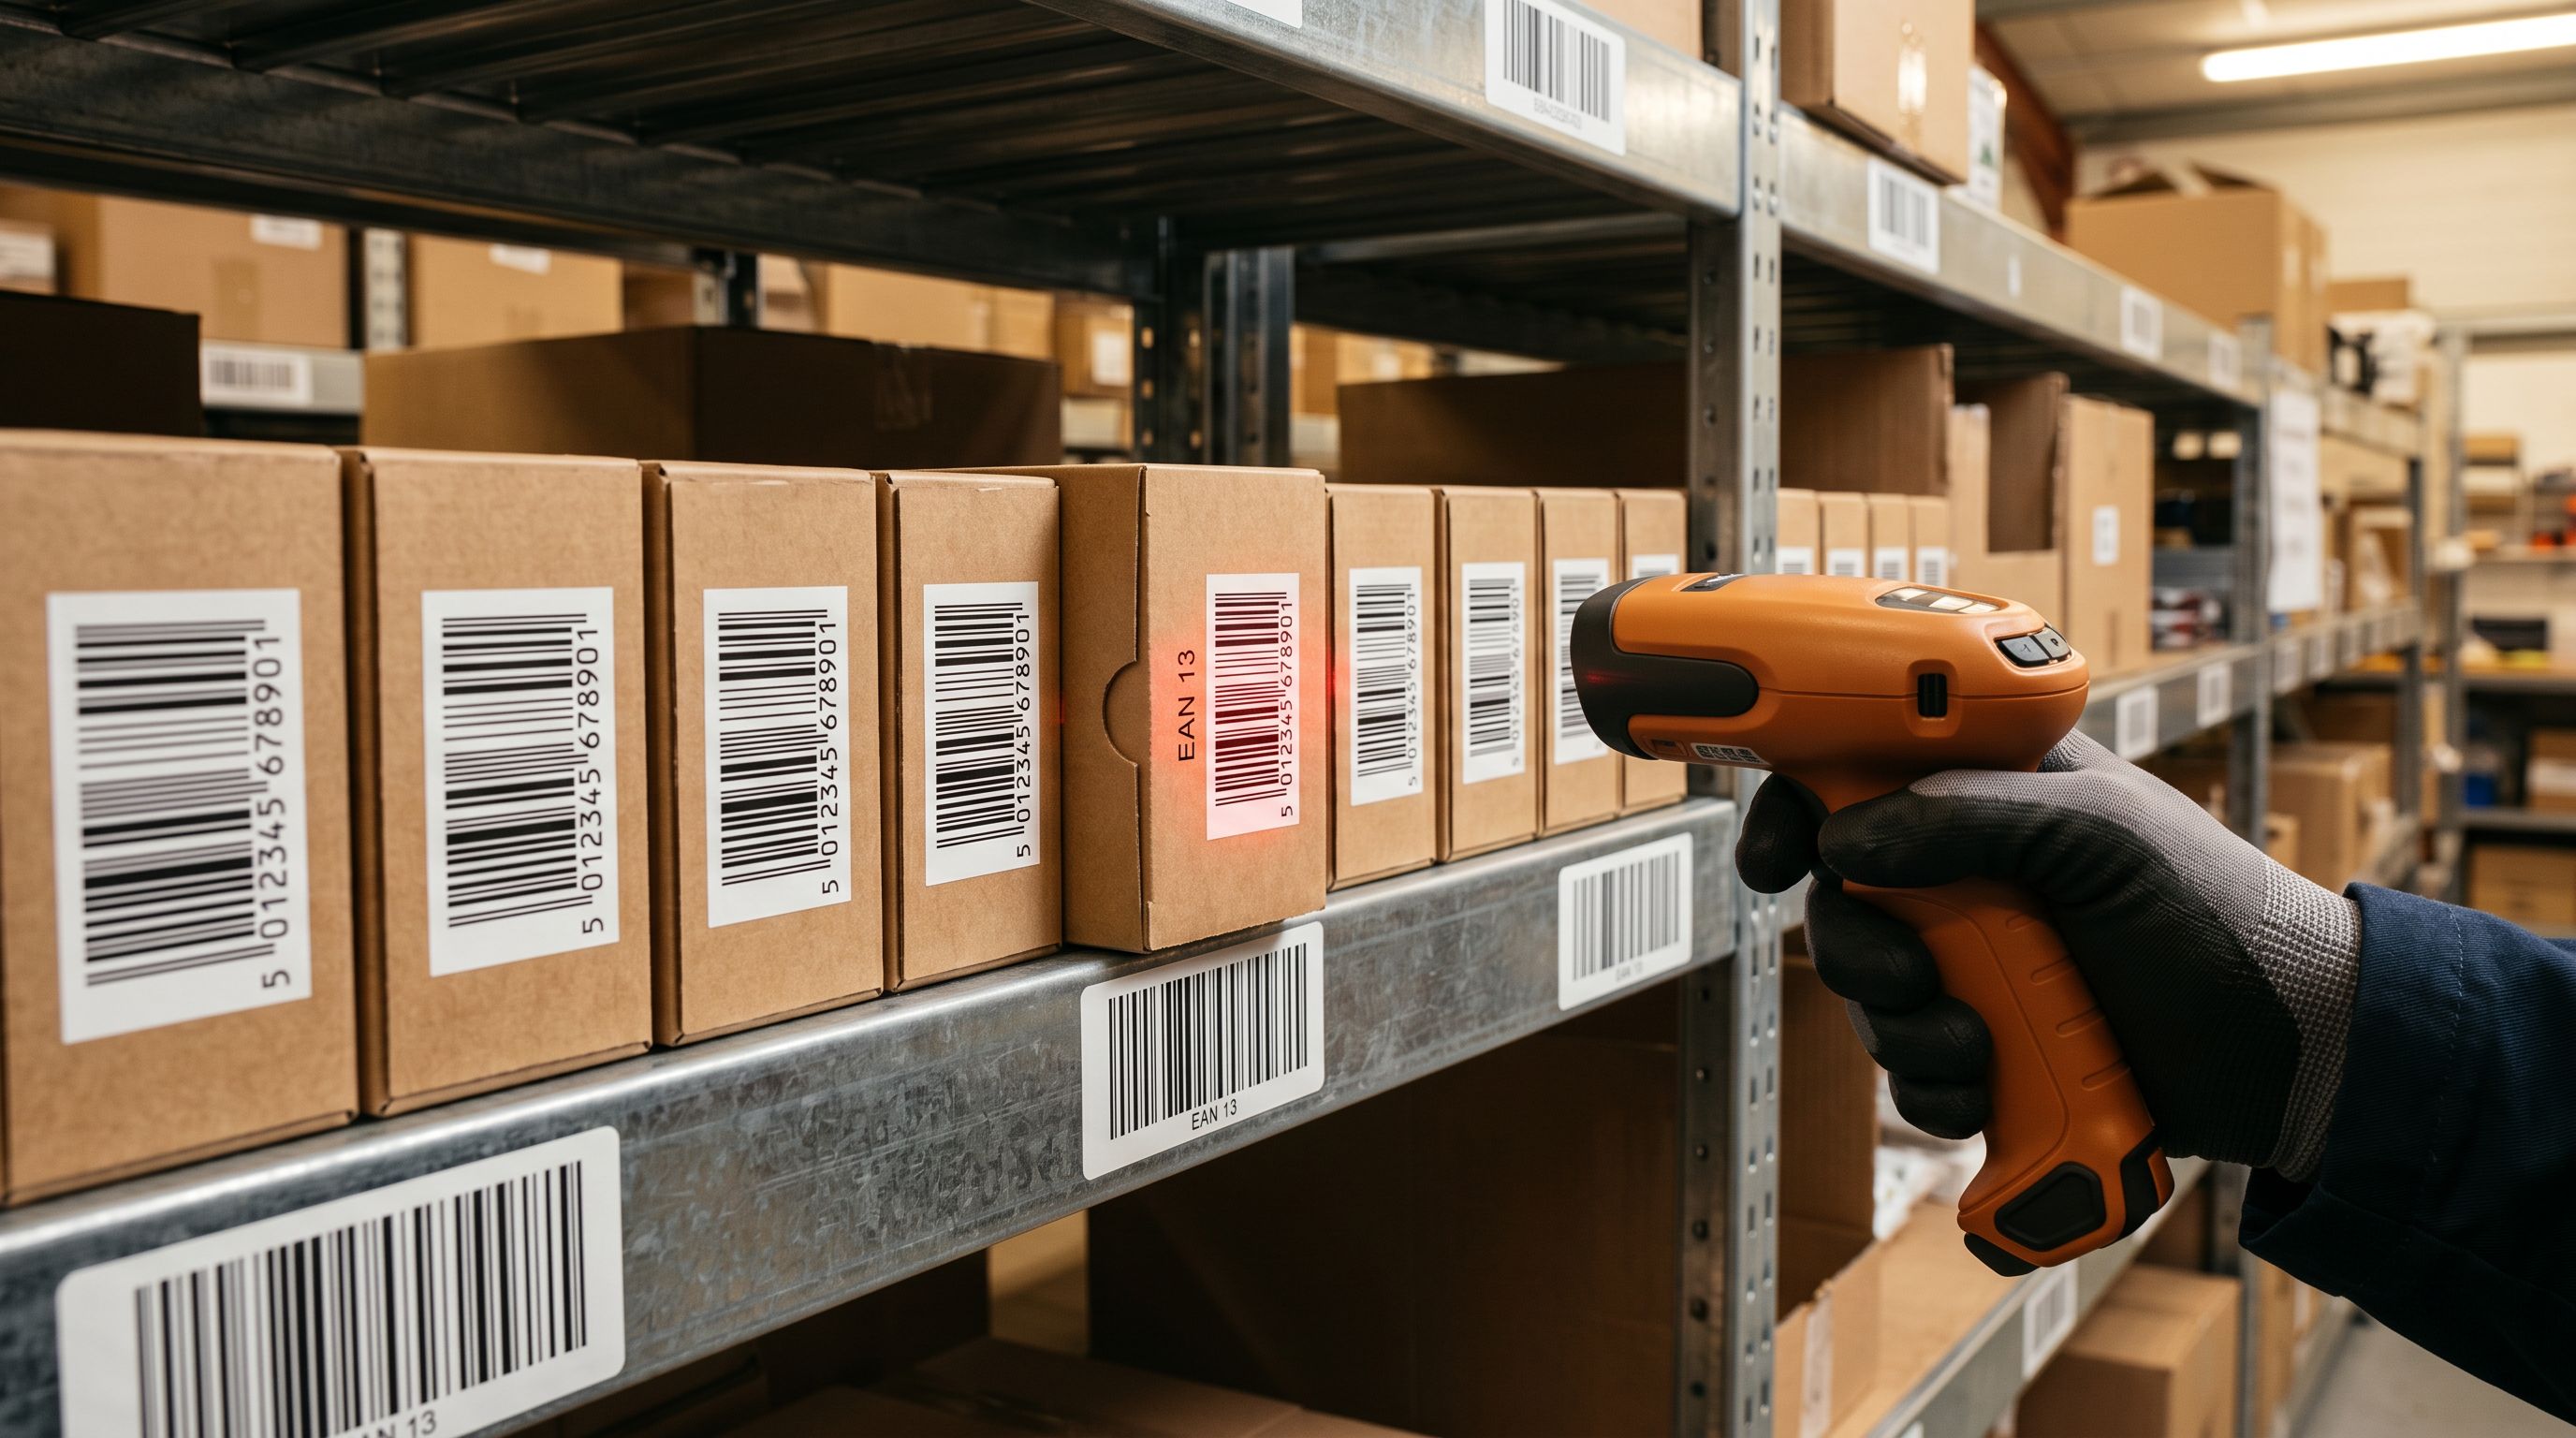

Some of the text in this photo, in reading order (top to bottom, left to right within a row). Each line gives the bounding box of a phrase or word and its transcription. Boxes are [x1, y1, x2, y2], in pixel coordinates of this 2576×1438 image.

[1016, 615, 1031, 858] 5 012345 678901
[1178, 650, 1195, 761] EAN 13
[1280, 603, 1294, 817] 5 012345 678901
[1406, 594, 1417, 670] 678901
[253, 638, 290, 989] 5 012345 678901
[577, 630, 604, 934] 5 012345 678901
[819, 624, 840, 894] 5 012345 678901
[1192, 1098, 1237, 1131] EAN 13
[408, 1409, 437, 1438] 13
